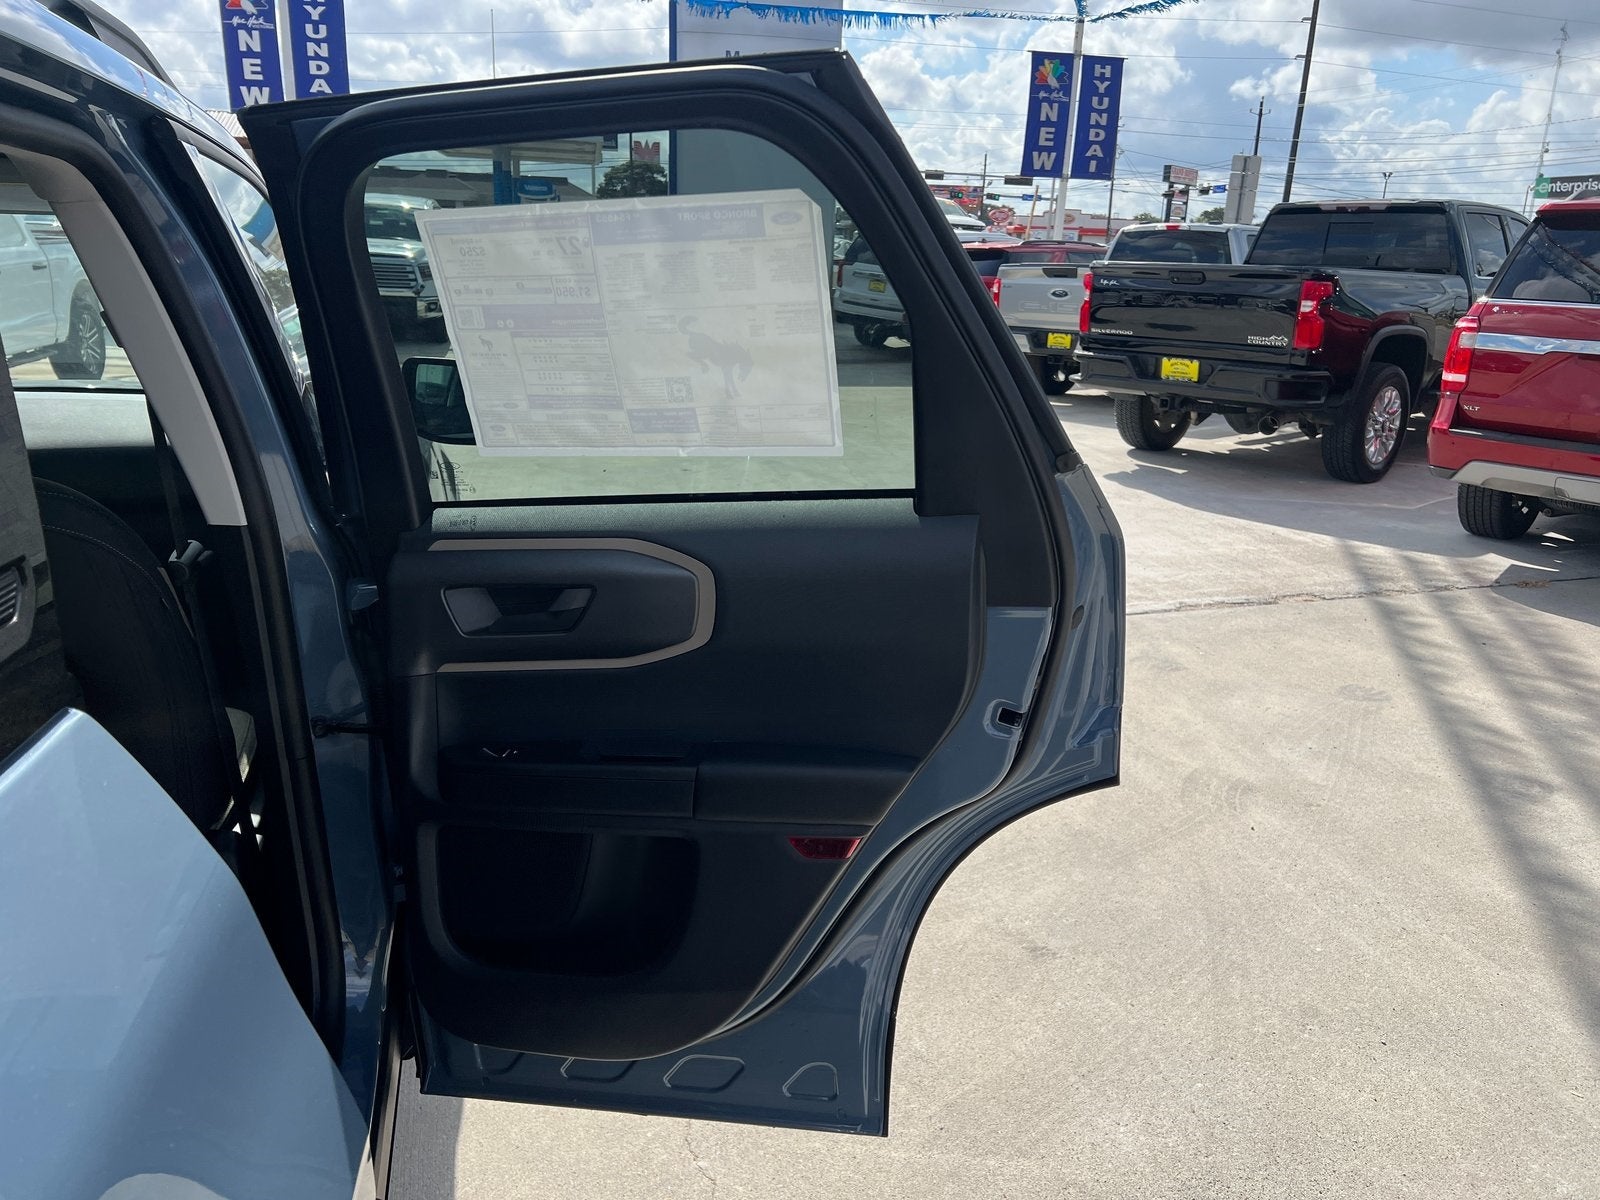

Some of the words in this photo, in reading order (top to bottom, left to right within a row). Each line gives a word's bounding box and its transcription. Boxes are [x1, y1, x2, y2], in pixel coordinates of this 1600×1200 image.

[238, 30, 270, 108] NEW
[303, 0, 332, 97] YUNDA
[1032, 102, 1059, 171] NEW
[1084, 64, 1112, 173] HYUNDAI
[1538, 178, 1600, 194] enterpris
[1247, 339, 1288, 347] COUNTRY
[1463, 404, 1480, 412] XLT
